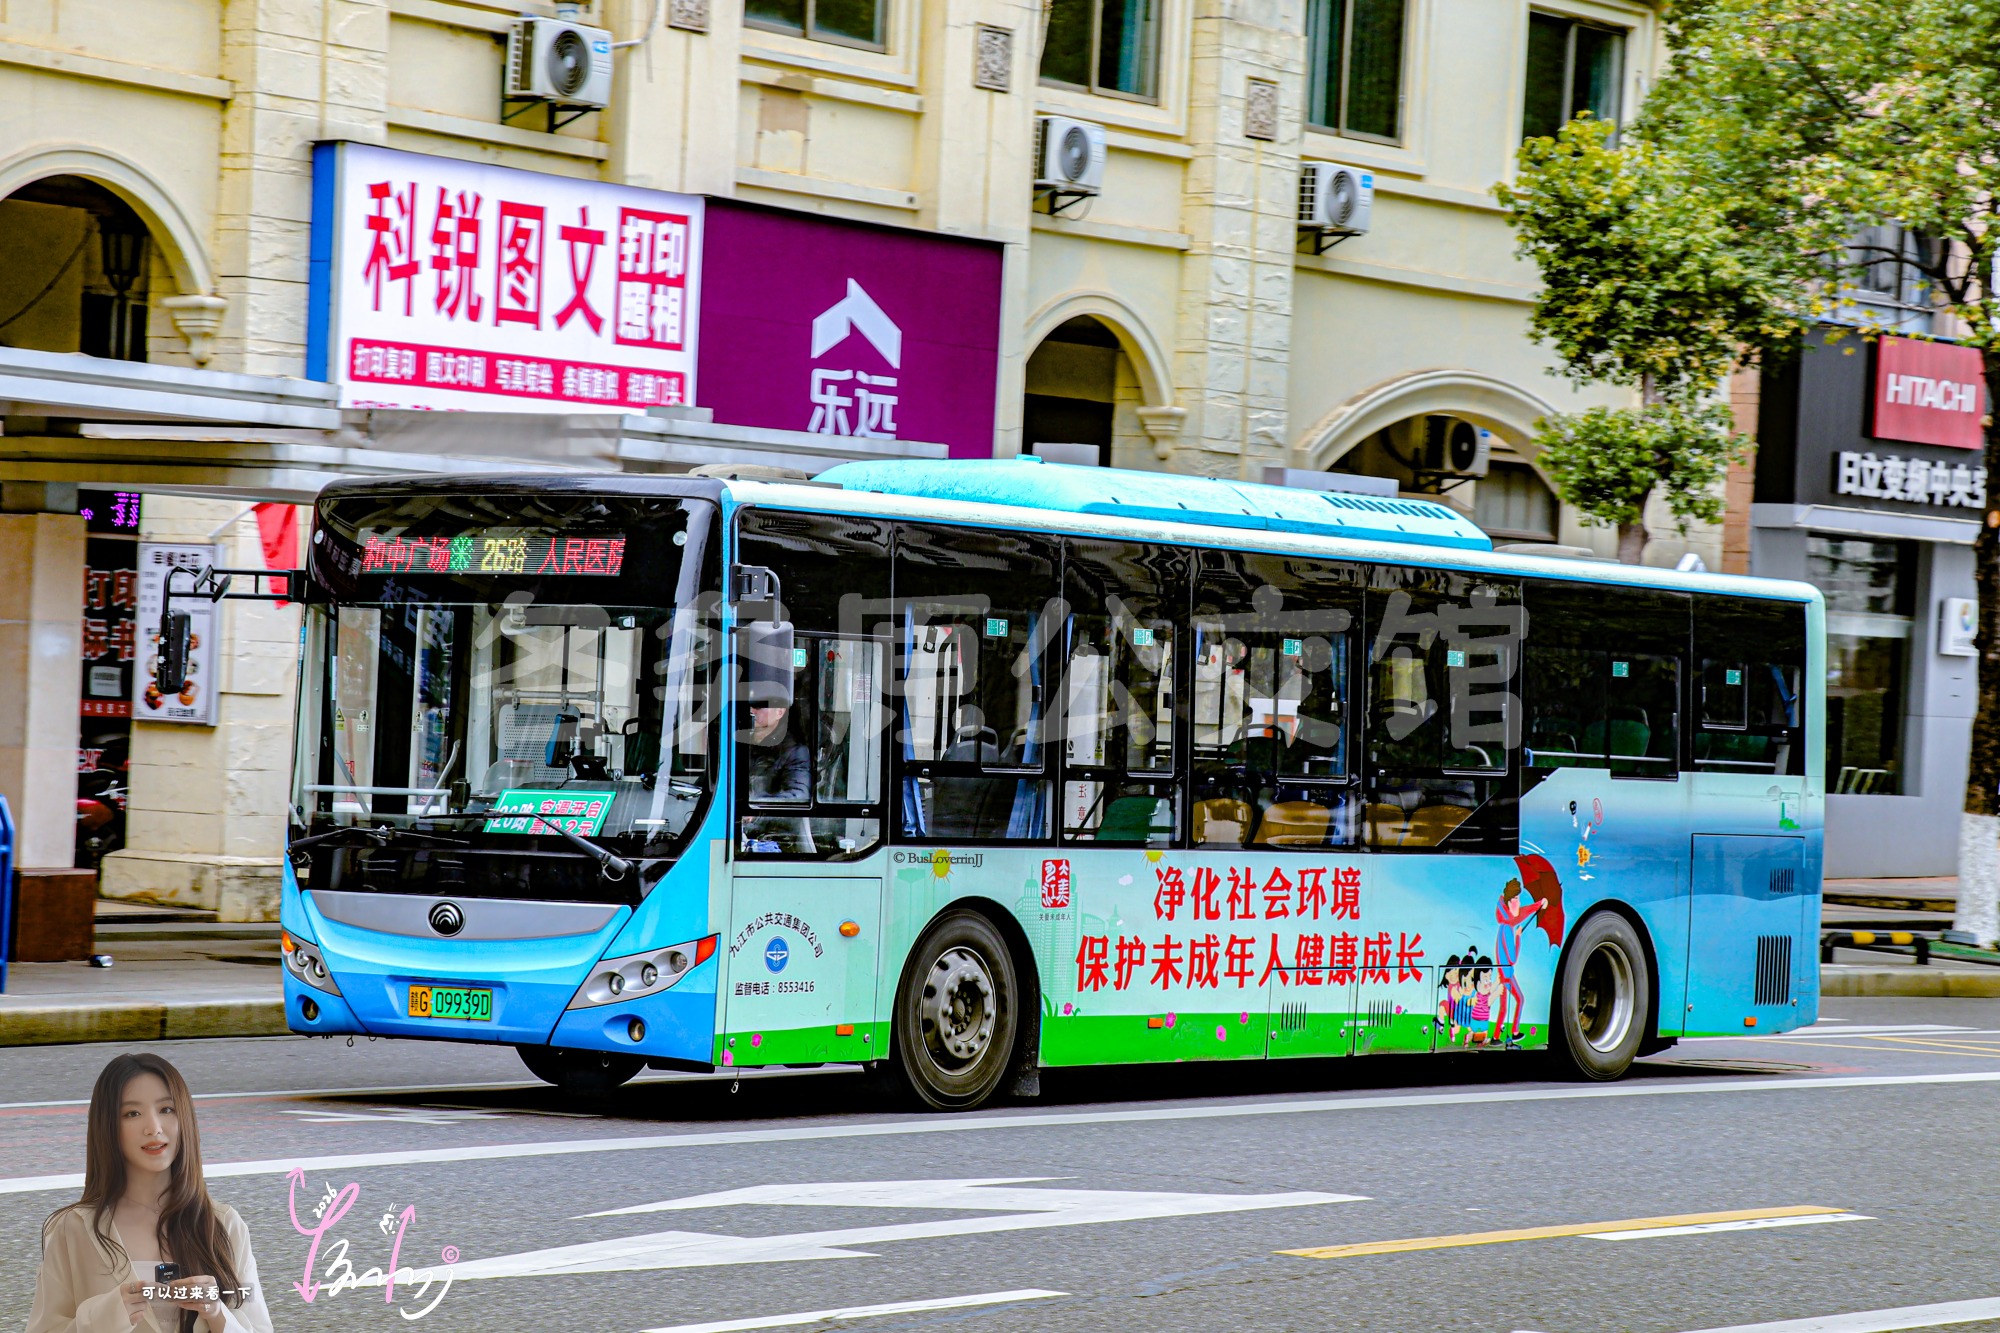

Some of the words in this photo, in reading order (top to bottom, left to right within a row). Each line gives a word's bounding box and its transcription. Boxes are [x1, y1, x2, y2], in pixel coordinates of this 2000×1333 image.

[363, 180, 607, 336] 科锐图文
[619, 215, 688, 280] 打印
[616, 282, 685, 345] 照相
[353, 344, 417, 380] 打印复印
[426, 351, 487, 388] 图文印刷
[1885, 373, 1977, 414] HITACHI
[807, 367, 898, 440] 乐远
[361, 535, 450, 574] 和中广场
[481, 537, 531, 574] 26路
[539, 799, 603, 818] 空调开启
[1152, 865, 1362, 921] 净化社会环境
[729, 912, 824, 959] 九江市公共交通集团公司
[1074, 930, 1425, 993] 保护未成年人健康成长
